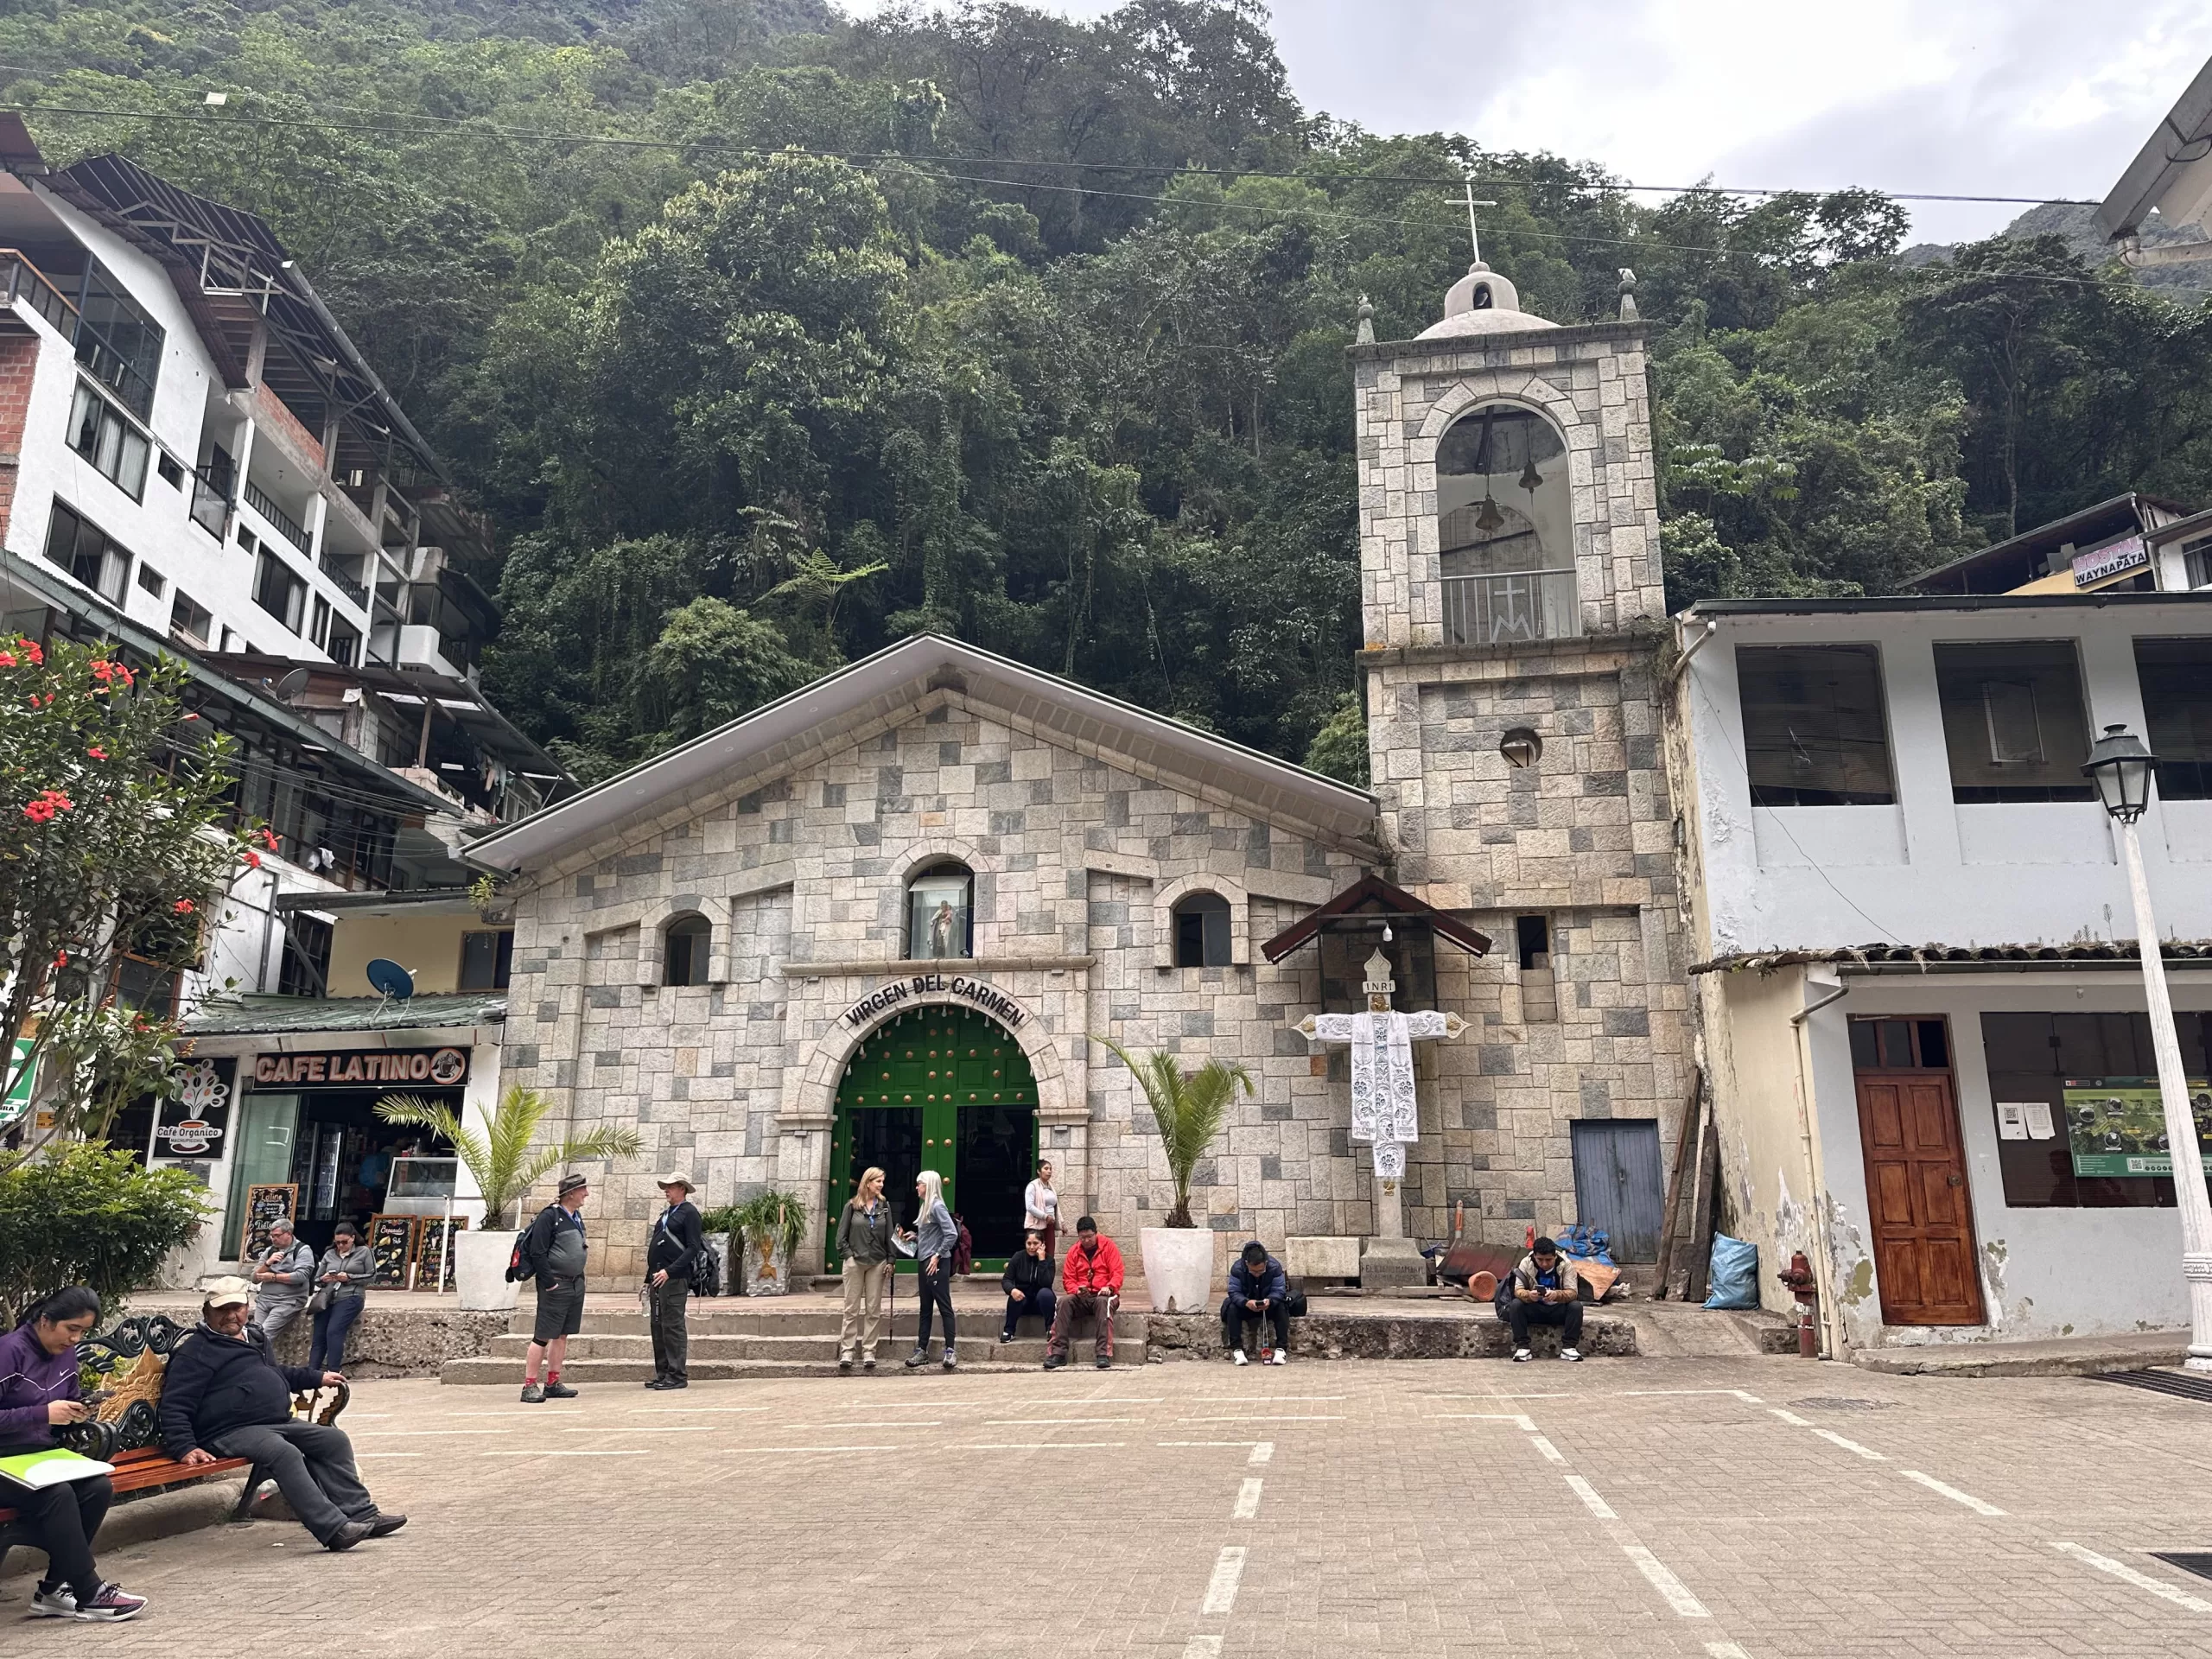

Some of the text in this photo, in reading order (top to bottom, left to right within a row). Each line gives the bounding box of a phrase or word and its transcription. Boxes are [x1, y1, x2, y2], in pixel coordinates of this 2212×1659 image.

[2072, 535, 2144, 574] HOSTAL
[2075, 553, 2145, 584] WAYNAPATA
[845, 975, 1026, 1027] VIRGEN DEL CARMEN
[1366, 982, 1392, 991] INRI
[256, 1053, 431, 1082] CAFE LATINO
[157, 1128, 219, 1138] Café Orgánico
